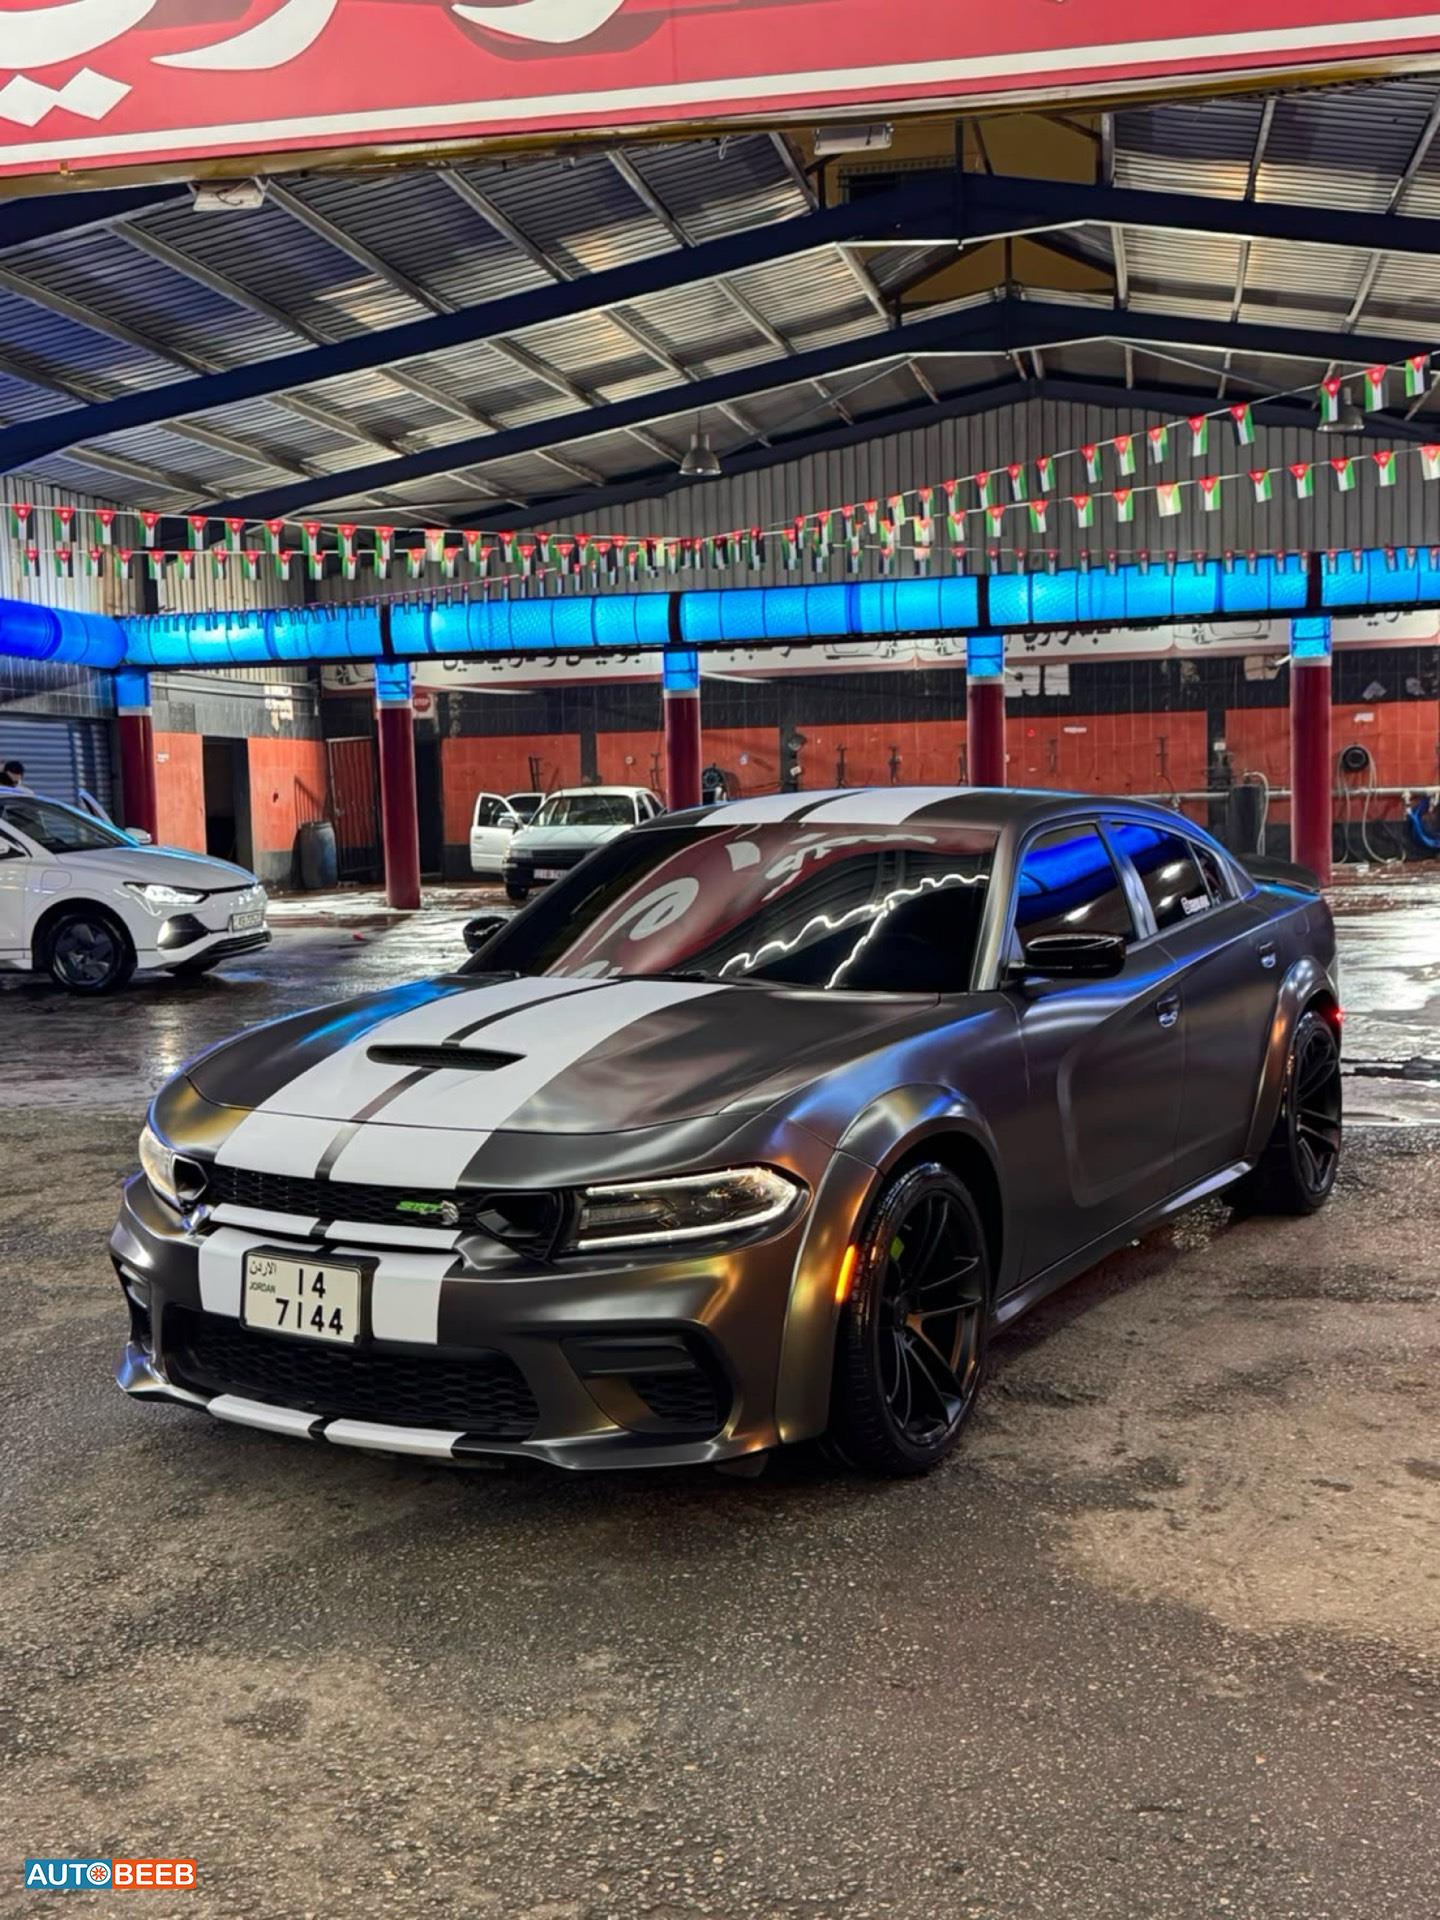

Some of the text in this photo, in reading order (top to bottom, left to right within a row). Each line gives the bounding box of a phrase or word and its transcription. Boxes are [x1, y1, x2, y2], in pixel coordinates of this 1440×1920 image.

[248, 1281, 277, 1294] JORDAN
[298, 1268, 326, 1299] 14
[275, 1297, 344, 1336] 7144
